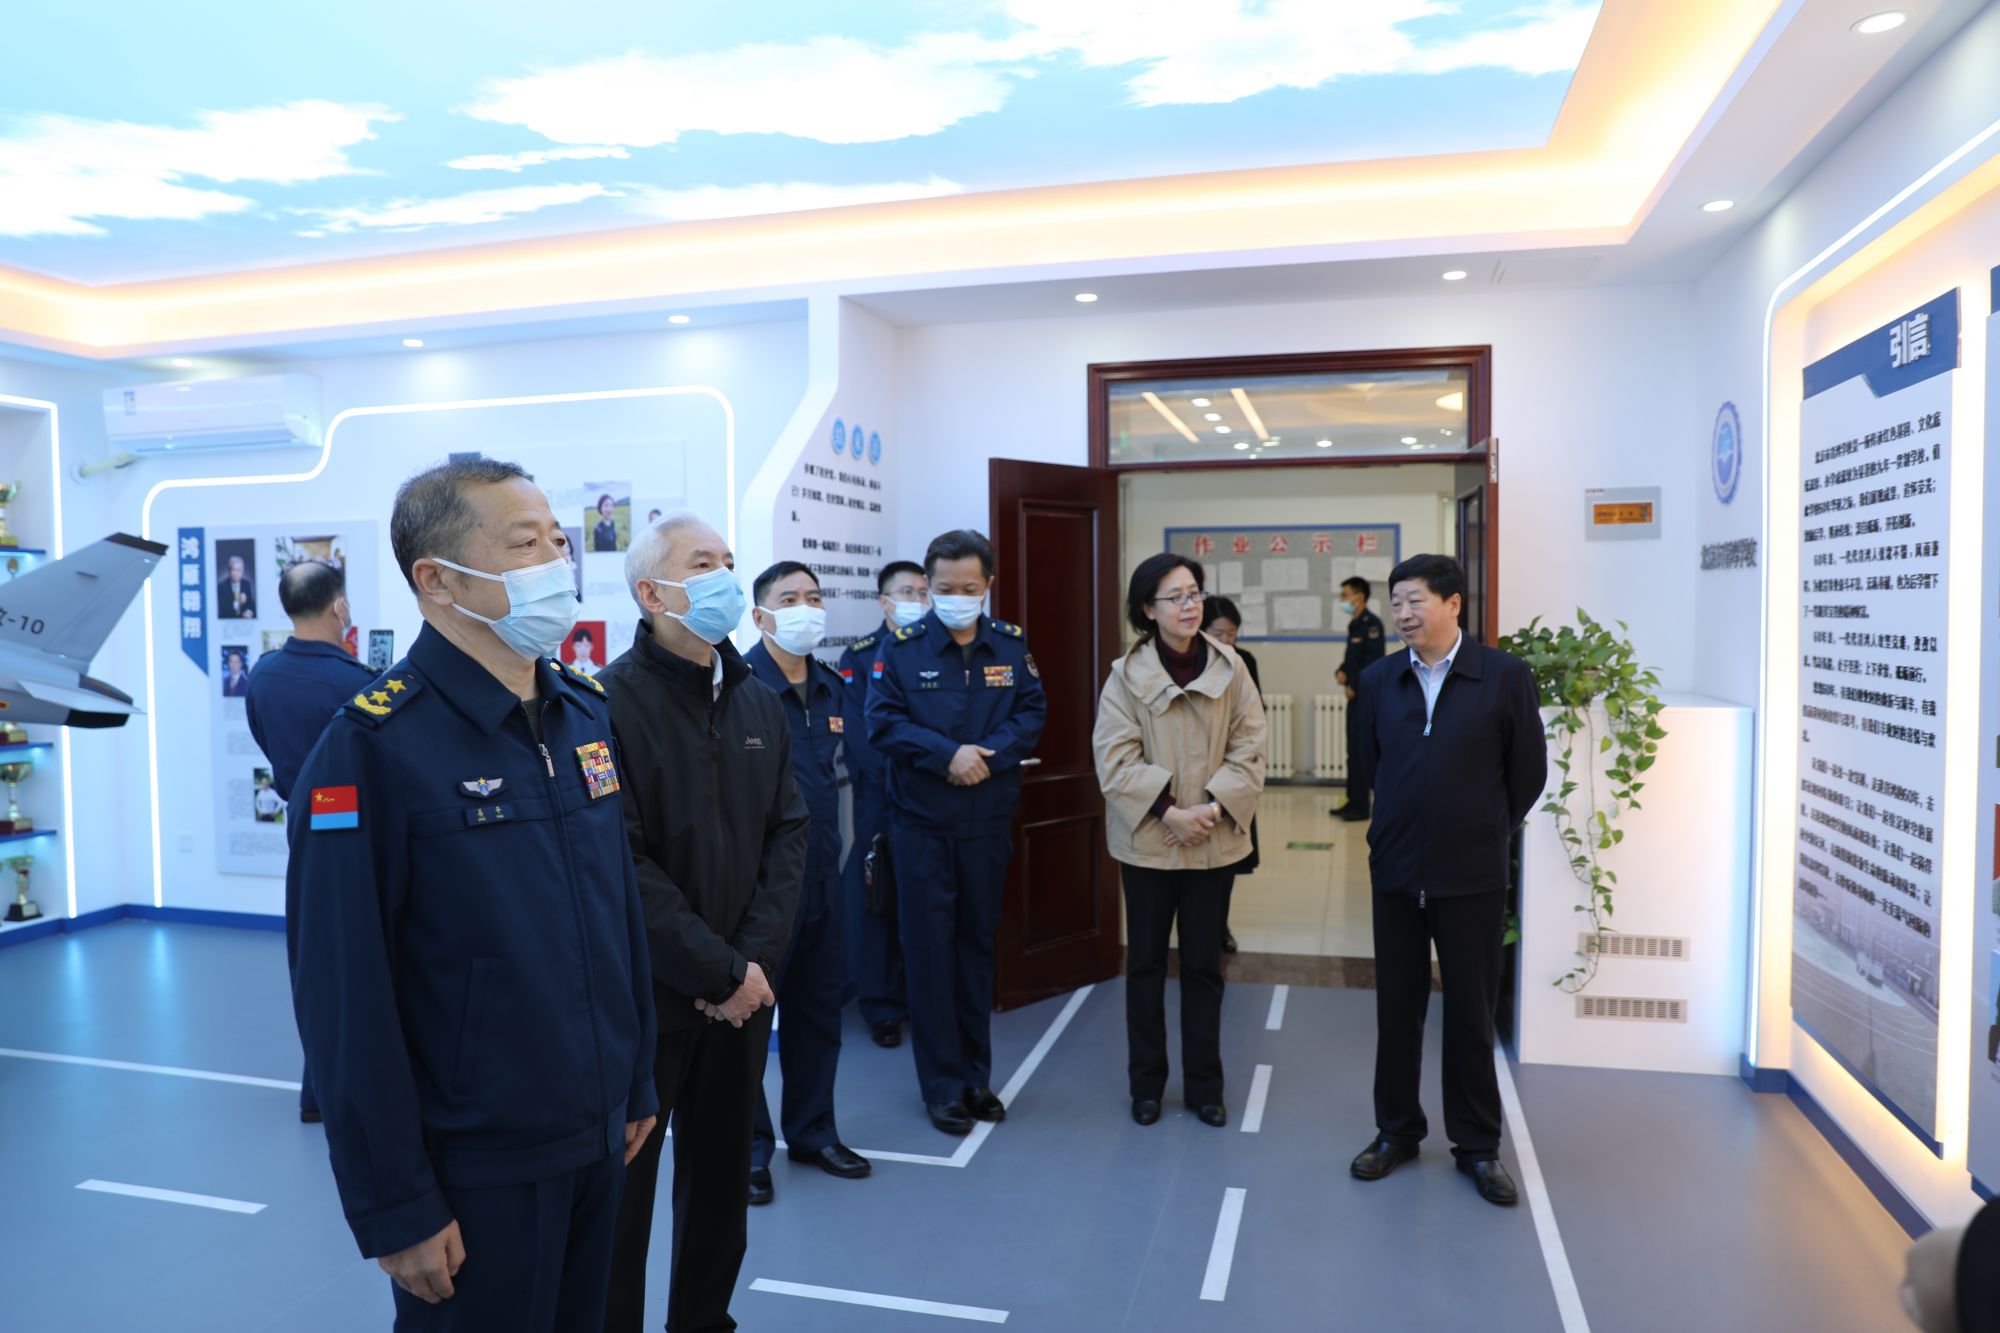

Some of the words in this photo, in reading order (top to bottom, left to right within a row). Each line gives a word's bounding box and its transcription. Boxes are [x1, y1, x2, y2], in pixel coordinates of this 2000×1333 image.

[1194, 533, 1379, 555] 作业公示栏
[181, 536, 202, 639] 鸿雁翱翔
